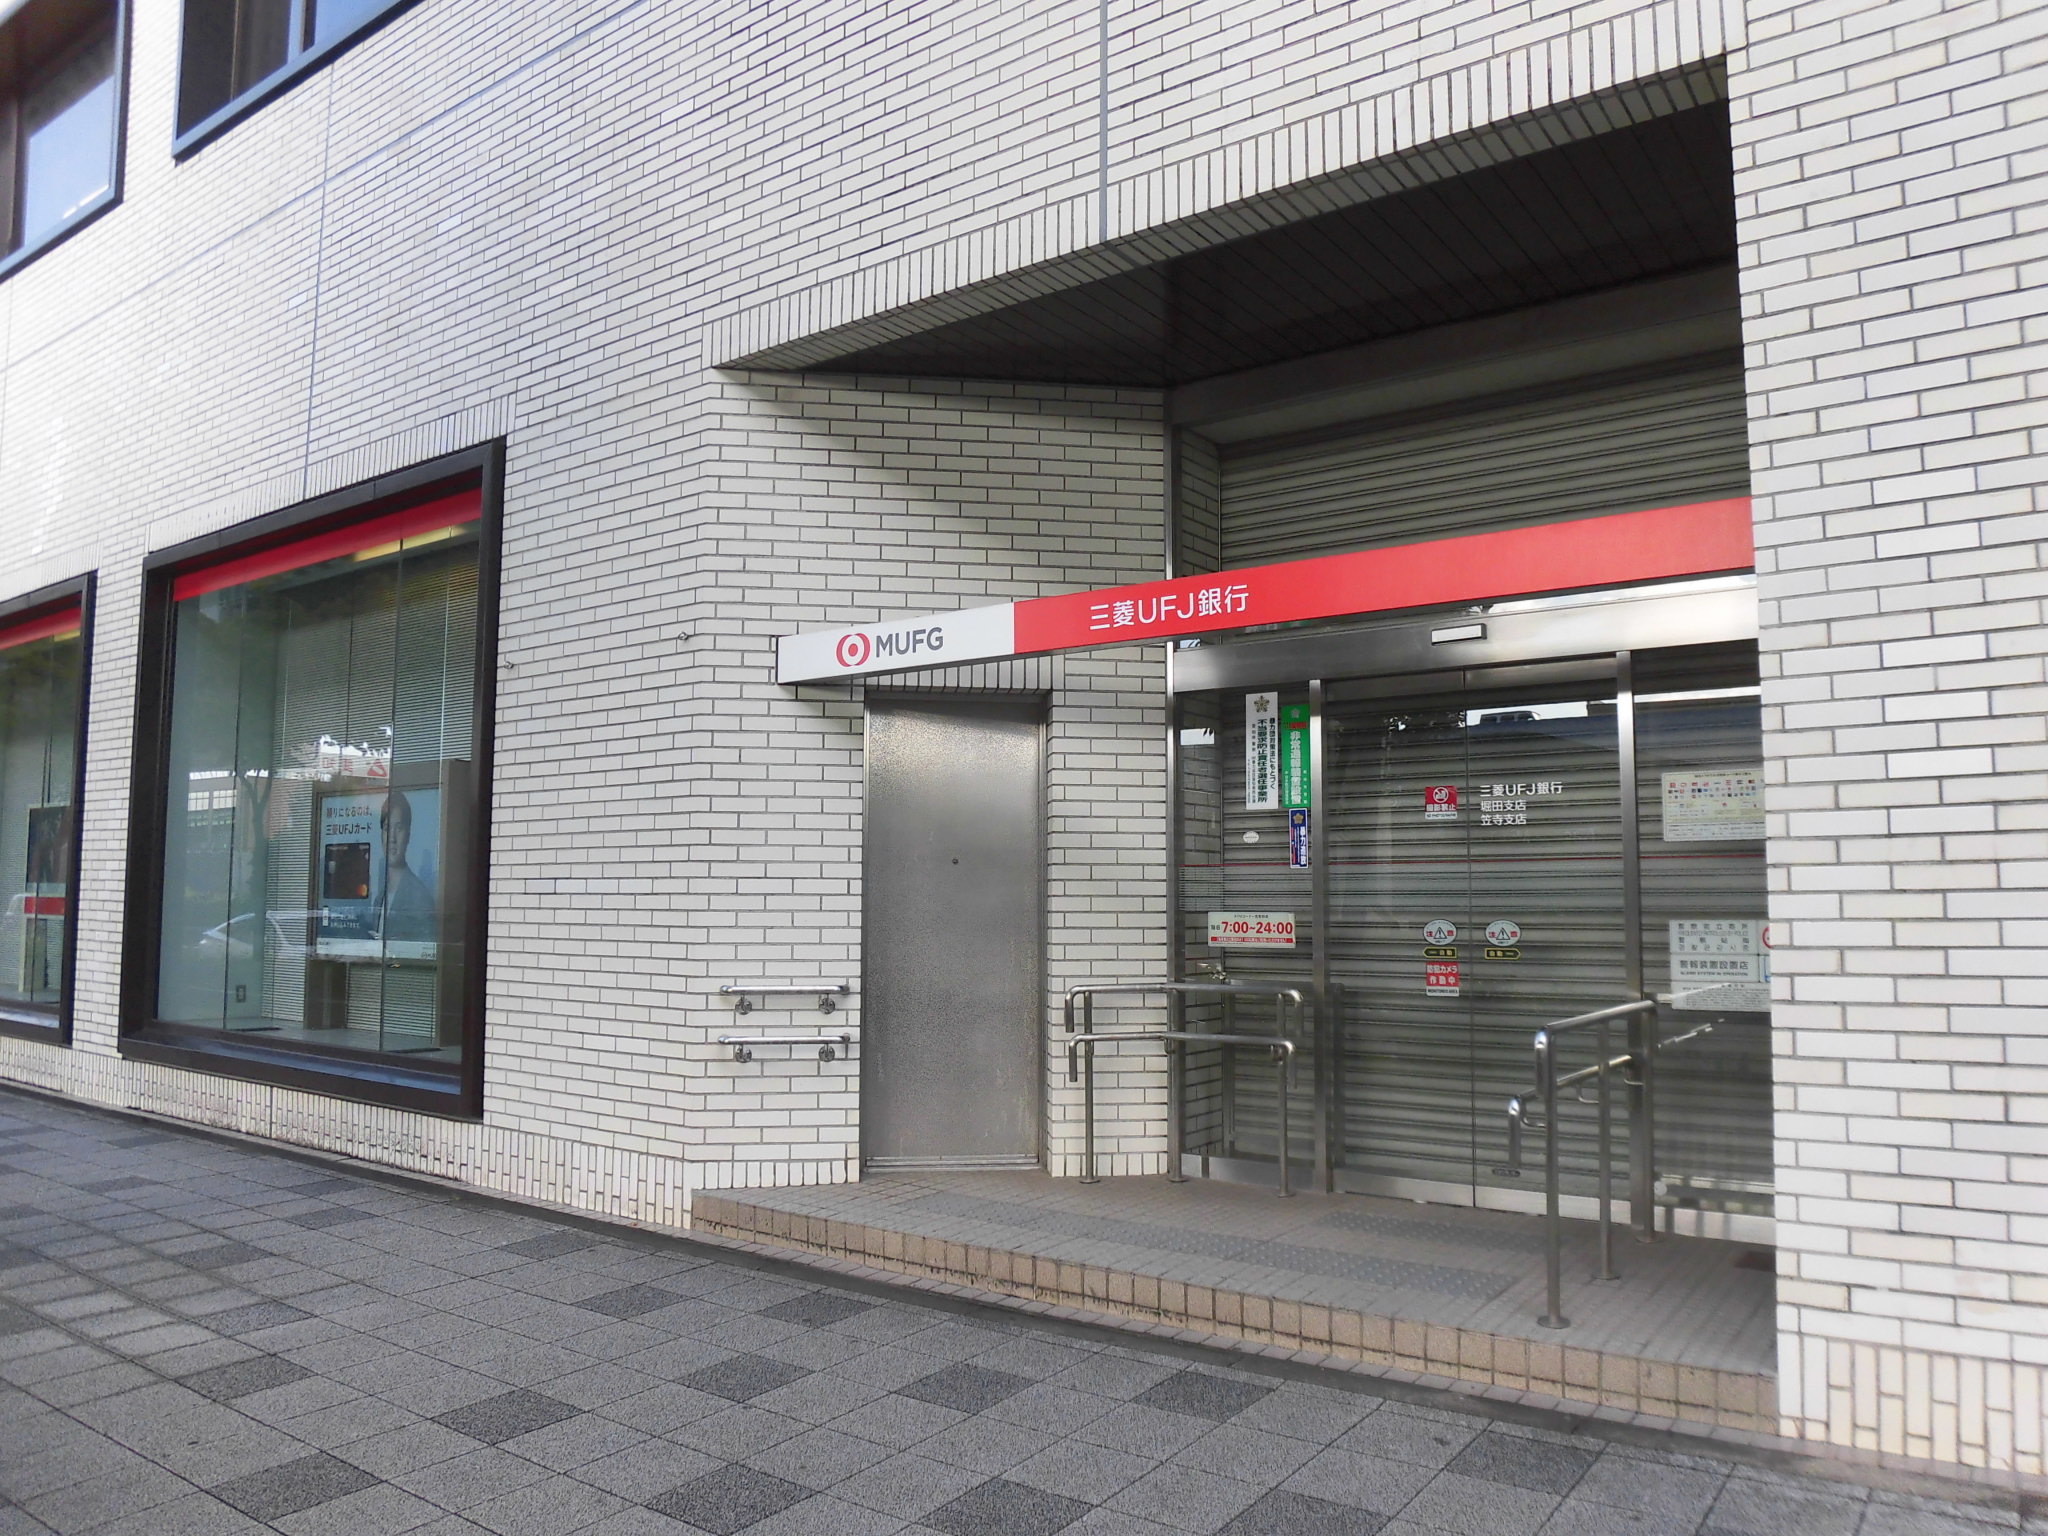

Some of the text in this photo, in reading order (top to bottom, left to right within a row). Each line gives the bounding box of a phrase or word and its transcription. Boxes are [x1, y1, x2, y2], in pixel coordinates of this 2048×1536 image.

[1089, 584, 1250, 632] 三菱UFJ銀行
[875, 626, 944, 659] MUFG
[1479, 781, 1564, 798] 三菱UFJ銀行
[1480, 799, 1527, 813] 堀田支店
[1480, 813, 1527, 826] 笠寺支店
